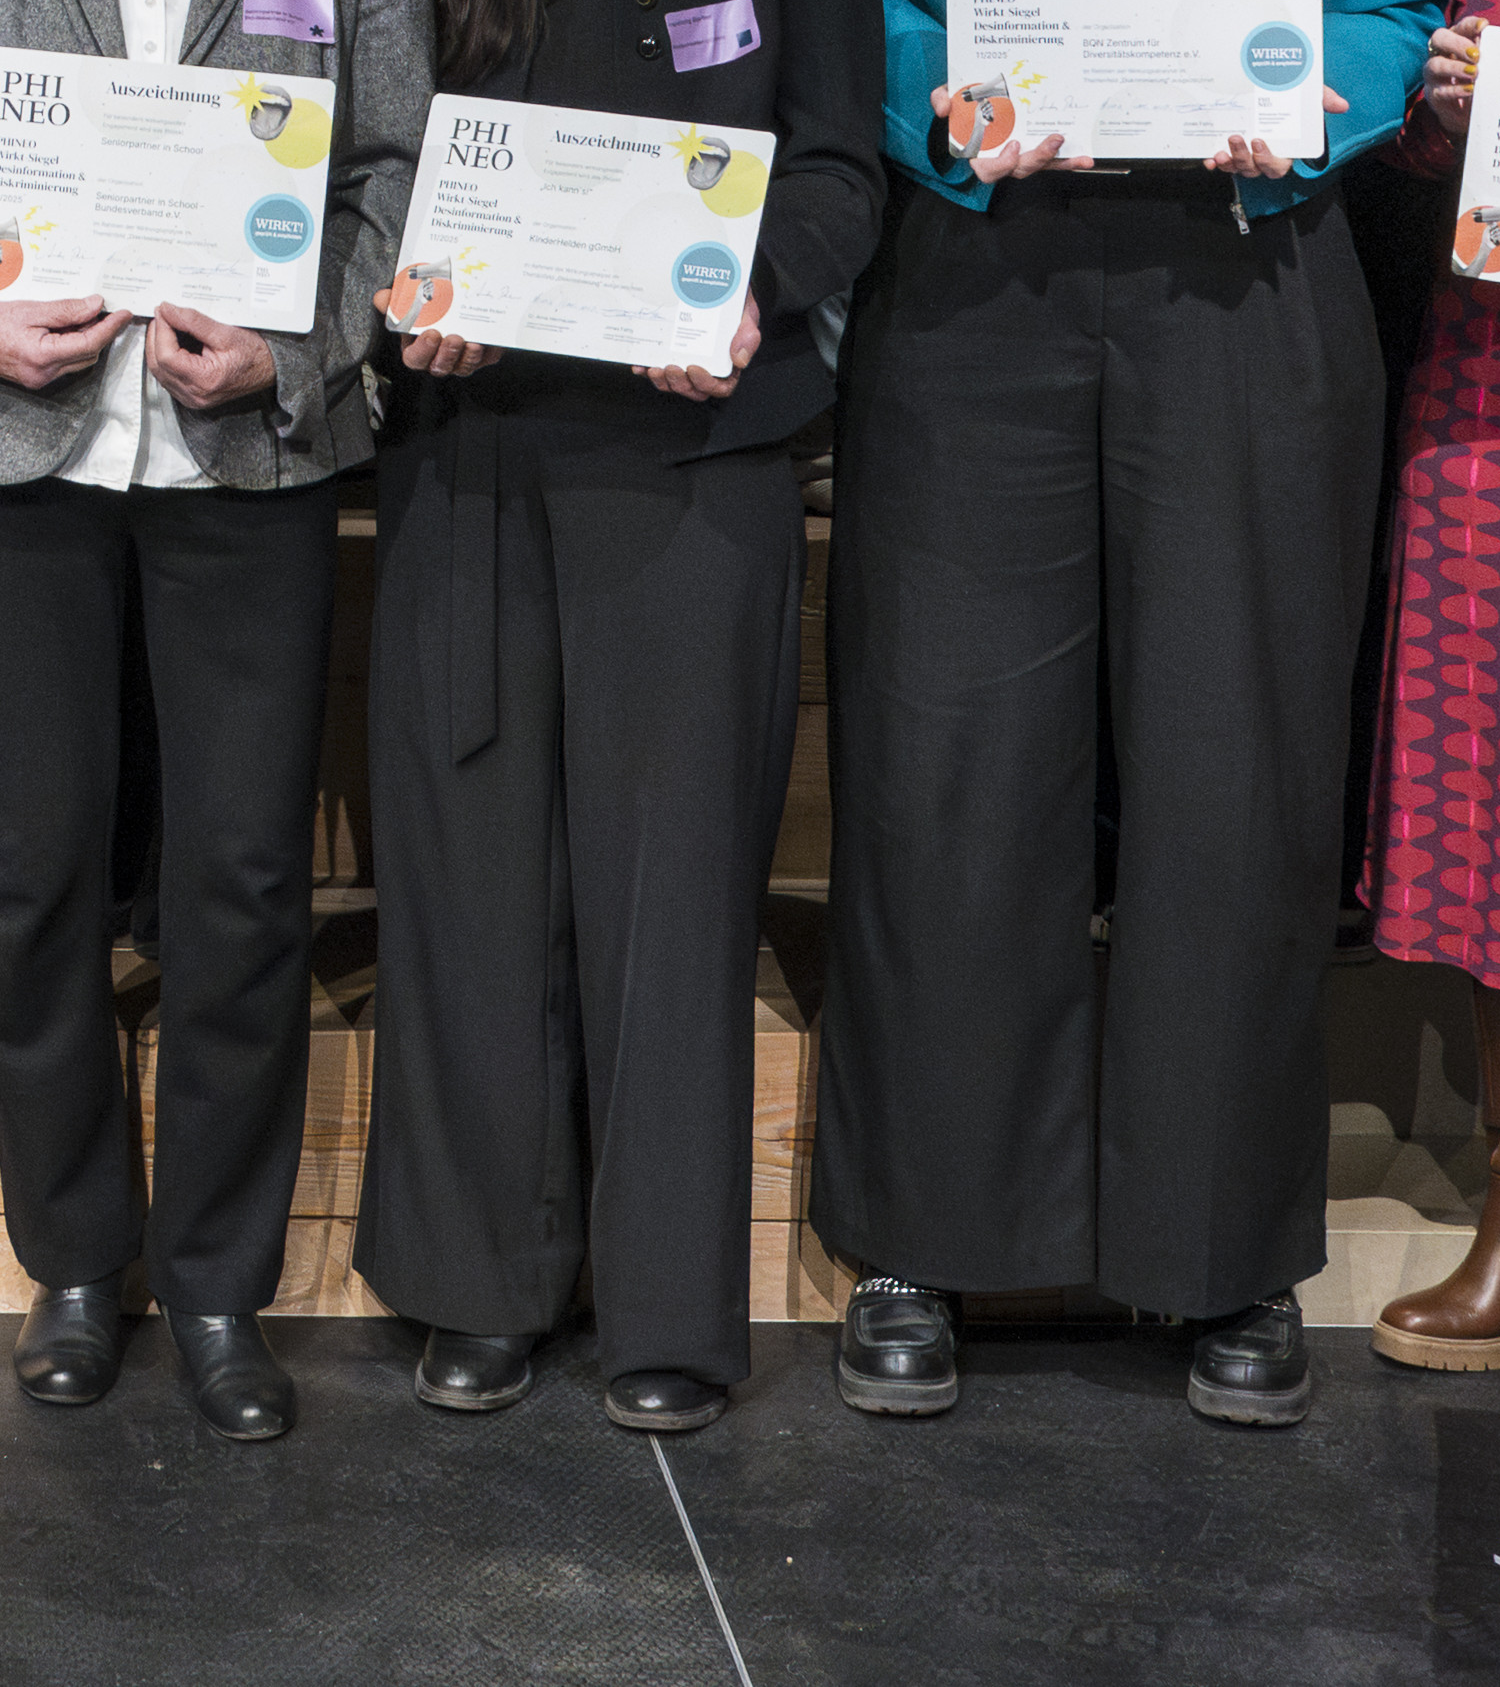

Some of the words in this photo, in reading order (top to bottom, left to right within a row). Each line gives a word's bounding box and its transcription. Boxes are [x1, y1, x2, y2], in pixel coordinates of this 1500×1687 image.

[1251, 47, 1302, 61] WIRKT!
[2, 70, 62, 98] PHI
[108, 81, 220, 107] Auszeichnung
[0, 97, 70, 124] NEO
[450, 117, 510, 145] PHI
[552, 129, 660, 156] Auszeichnung
[100, 136, 160, 150] Seniorpartner
[173, 143, 203, 154] School
[445, 142, 513, 170] NEO
[255, 217, 303, 235] WIRKT!
[683, 264, 731, 282] WIRKT!
